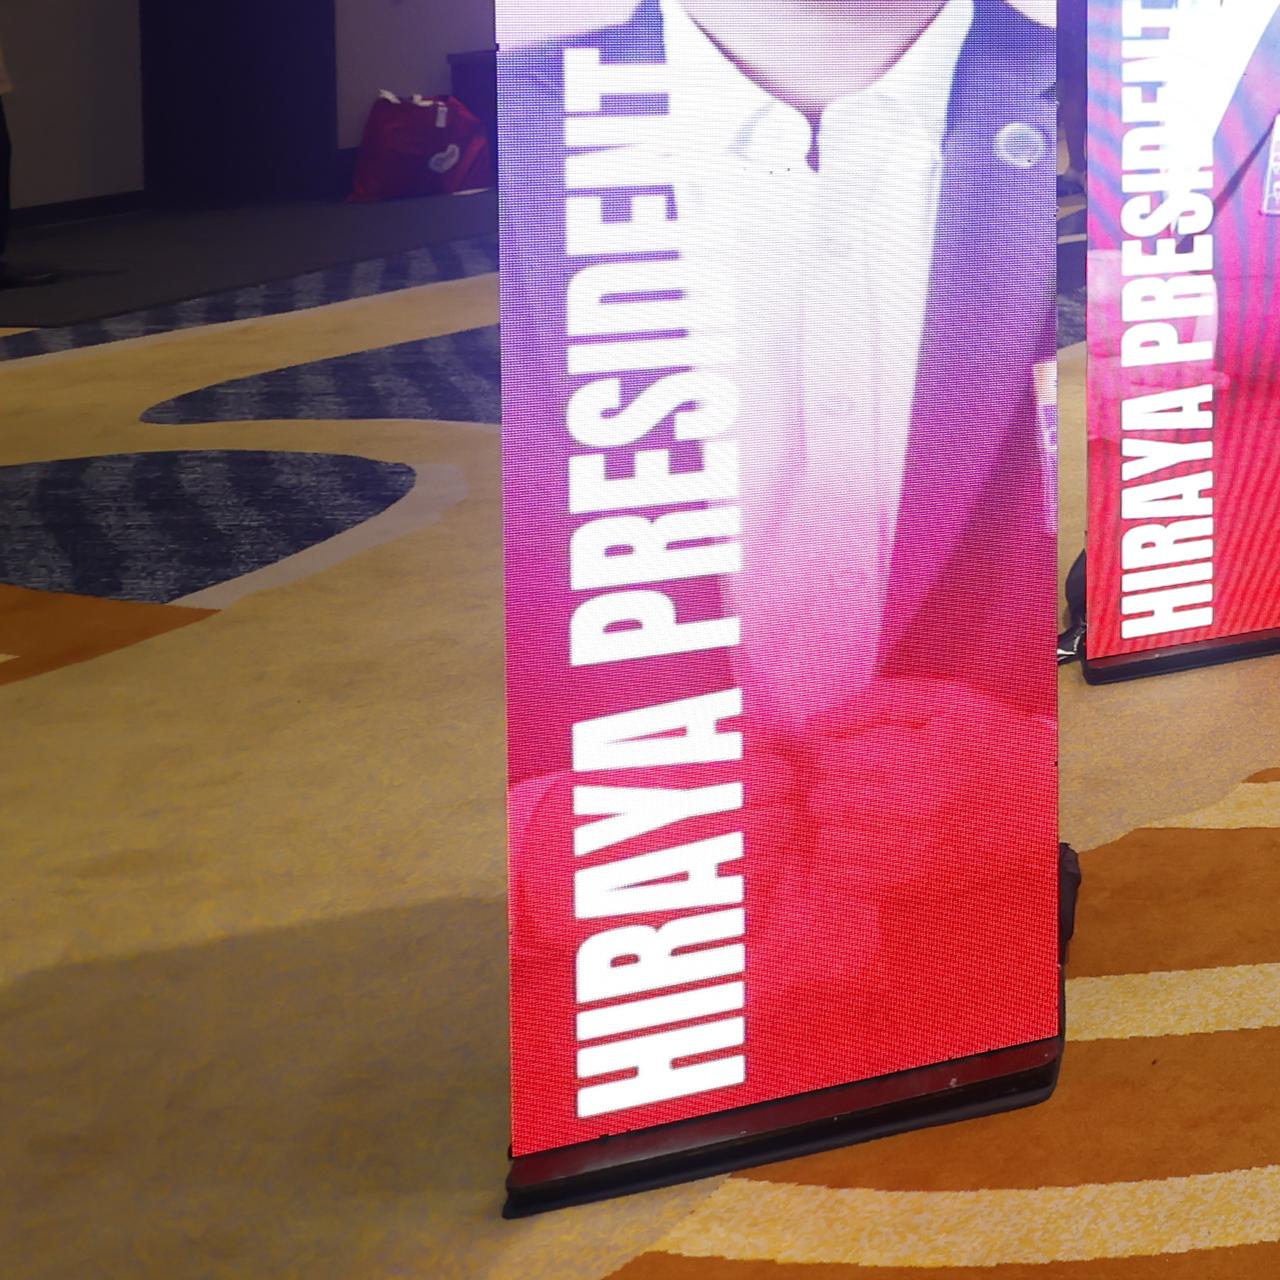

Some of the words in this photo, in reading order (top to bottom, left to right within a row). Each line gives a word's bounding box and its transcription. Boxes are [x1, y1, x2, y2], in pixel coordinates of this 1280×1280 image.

[563, 47, 743, 666] PRESIDENT
[1121, 384, 1214, 639] HIRAYA
[571, 687, 746, 1118] HIRAYA
